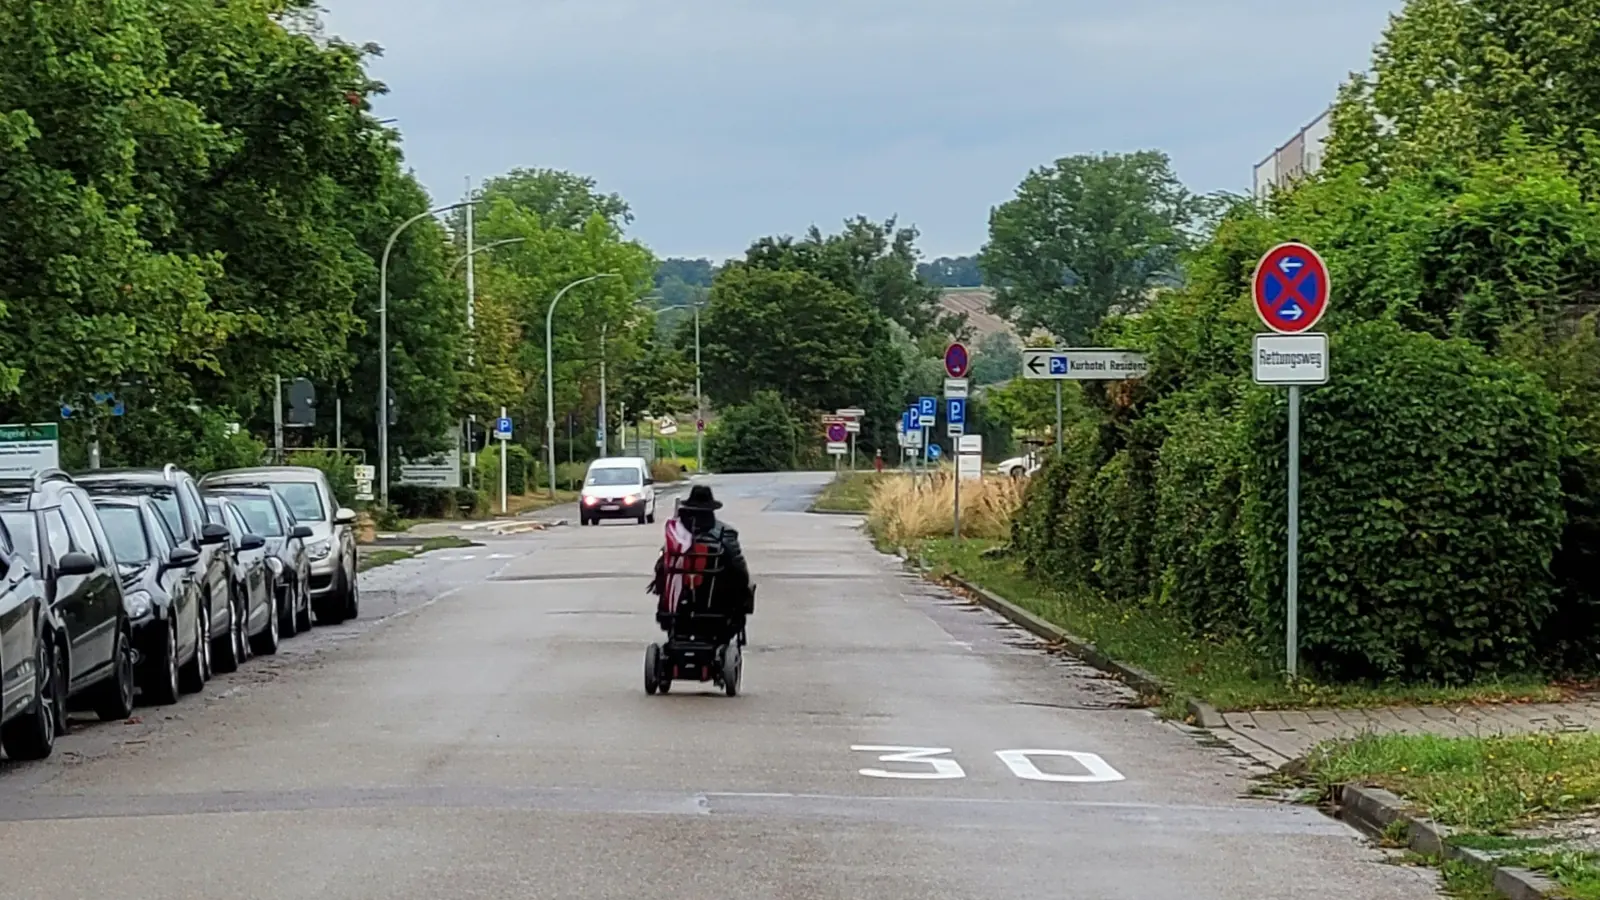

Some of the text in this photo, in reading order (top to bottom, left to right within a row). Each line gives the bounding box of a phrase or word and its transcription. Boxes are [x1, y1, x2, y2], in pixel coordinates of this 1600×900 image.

[1070, 360, 1106, 370] Kurhotel
[1259, 349, 1322, 369] Rettungsweg
[850, 744, 1126, 782] 30
